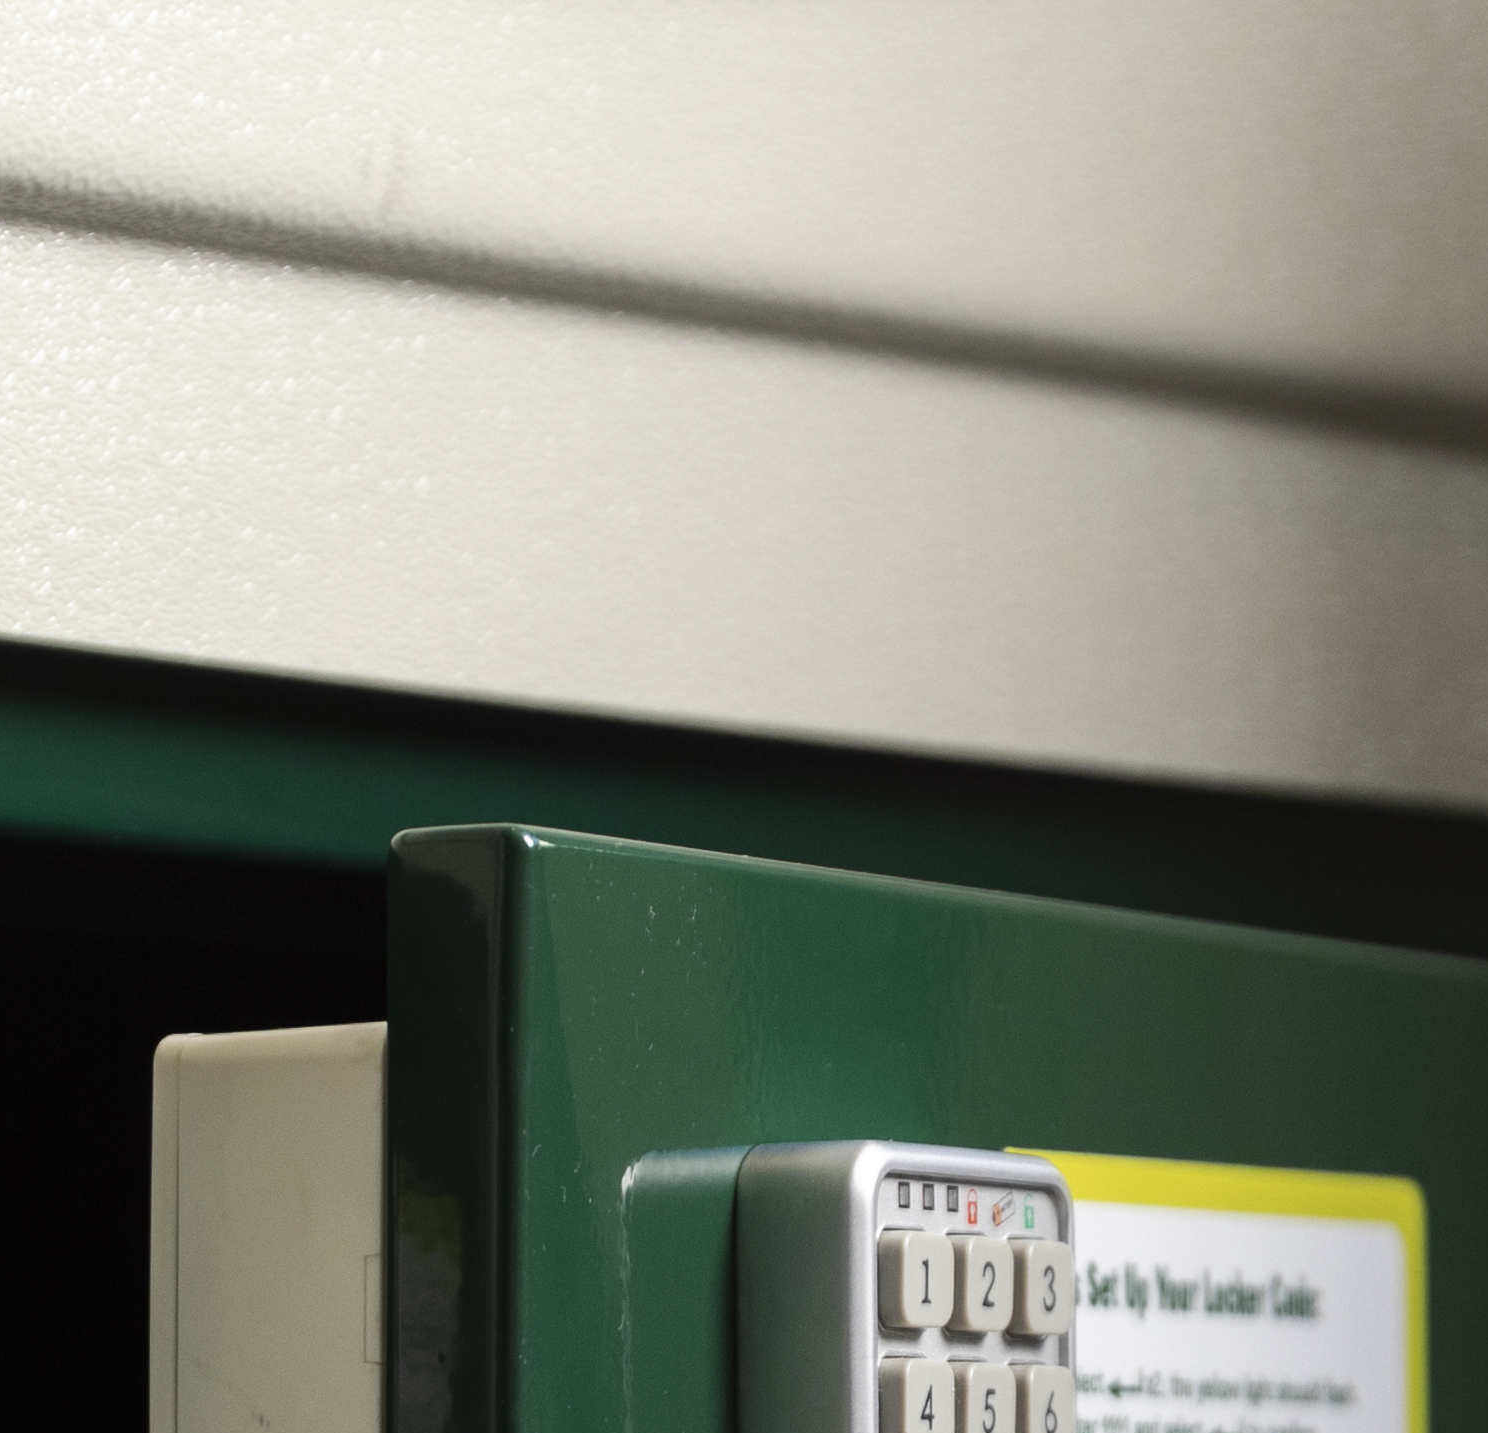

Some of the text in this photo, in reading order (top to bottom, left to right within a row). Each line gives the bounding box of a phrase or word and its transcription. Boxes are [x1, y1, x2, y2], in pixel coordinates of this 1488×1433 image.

[919, 1257, 933, 1306] 1
[980, 1260, 997, 1310] 2
[1042, 1264, 1058, 1315] 3
[1086, 1261, 1118, 1309] Set
[1124, 1261, 1148, 1320] Up
[1154, 1263, 1198, 1313] Your
[918, 1384, 936, 1431] 4
